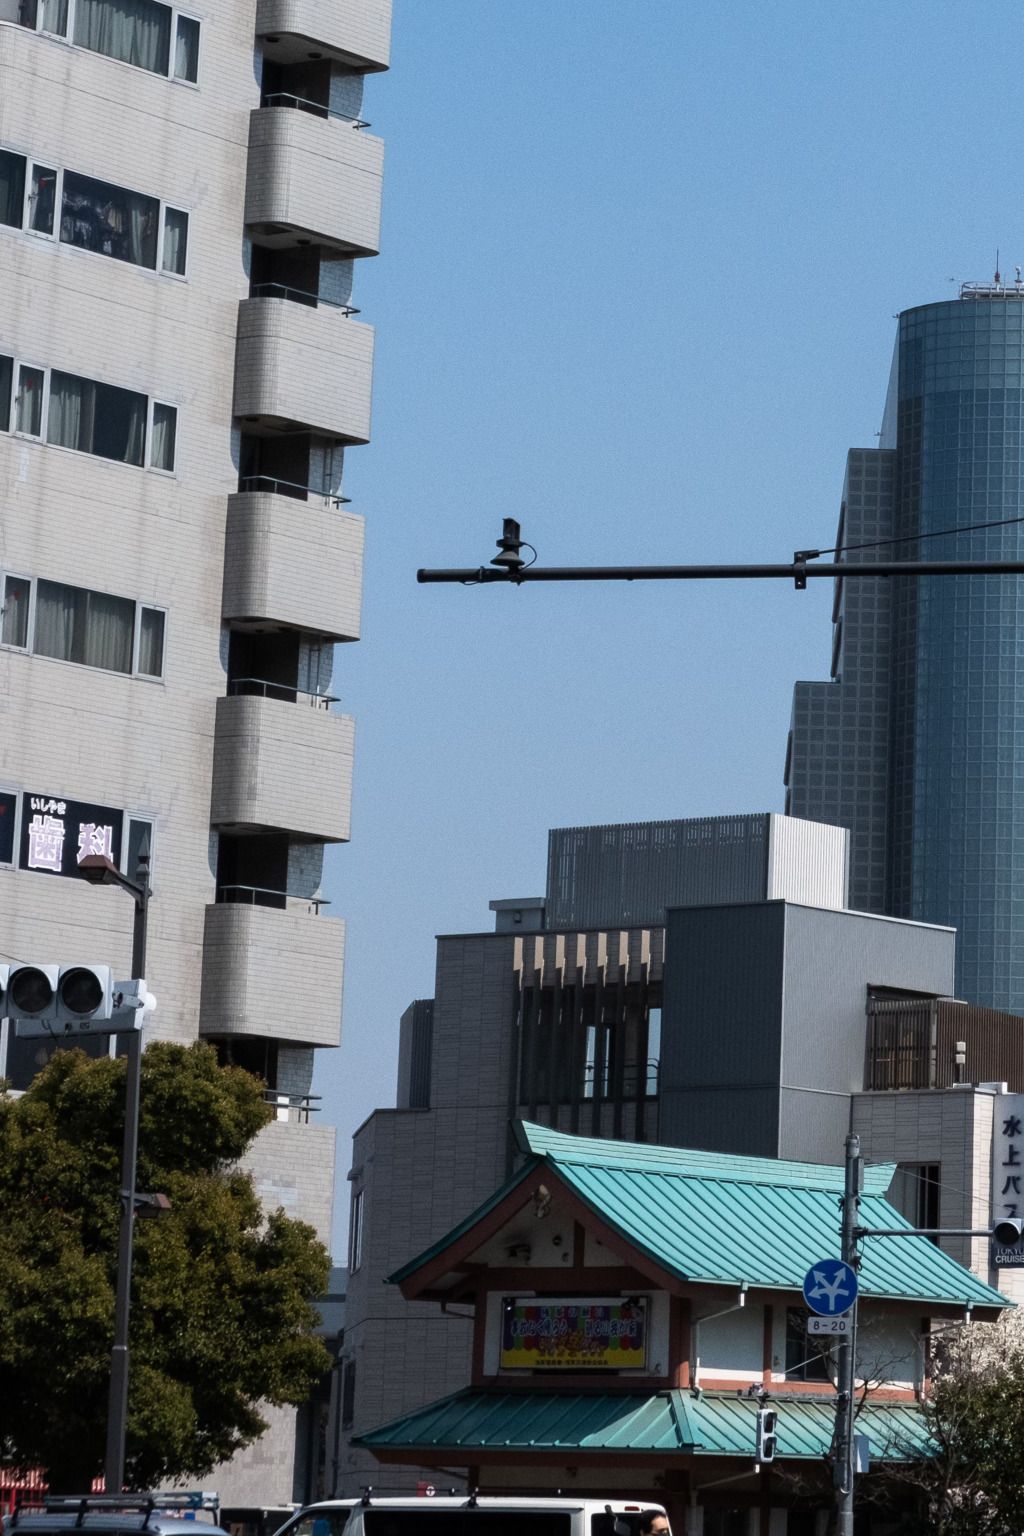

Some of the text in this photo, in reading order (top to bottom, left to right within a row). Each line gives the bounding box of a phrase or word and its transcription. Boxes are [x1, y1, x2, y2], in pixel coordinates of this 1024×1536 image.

[30, 797, 67, 815] いしやま
[28, 814, 114, 872] 歯科
[813, 1320, 846, 1331] 8-20
